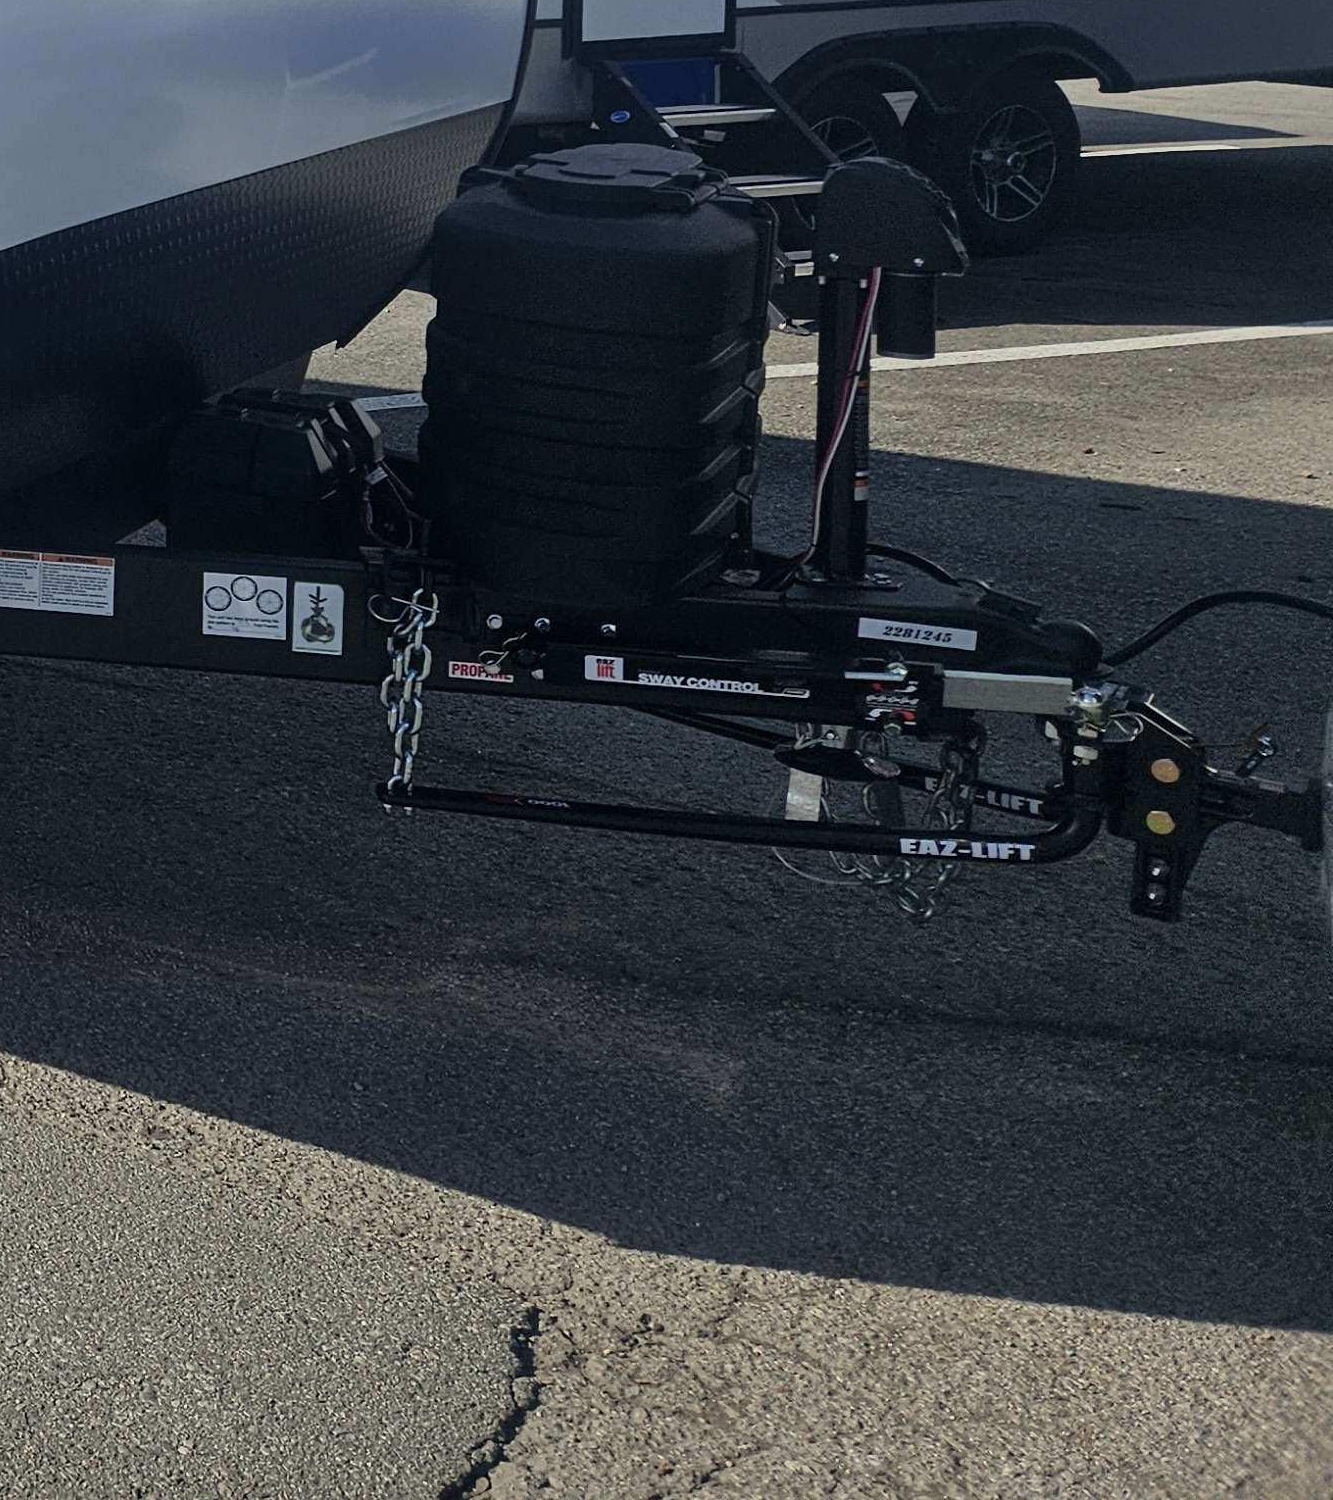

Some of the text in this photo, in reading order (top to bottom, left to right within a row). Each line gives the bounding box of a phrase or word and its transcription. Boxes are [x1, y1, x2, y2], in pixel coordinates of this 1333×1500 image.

[883, 625, 953, 644] 2281245
[597, 663, 616, 679] lift
[638, 673, 764, 694] SWAY CONTROL
[924, 776, 1044, 815] EZ-LIFT
[900, 838, 1036, 861] EAZ-LIFT
